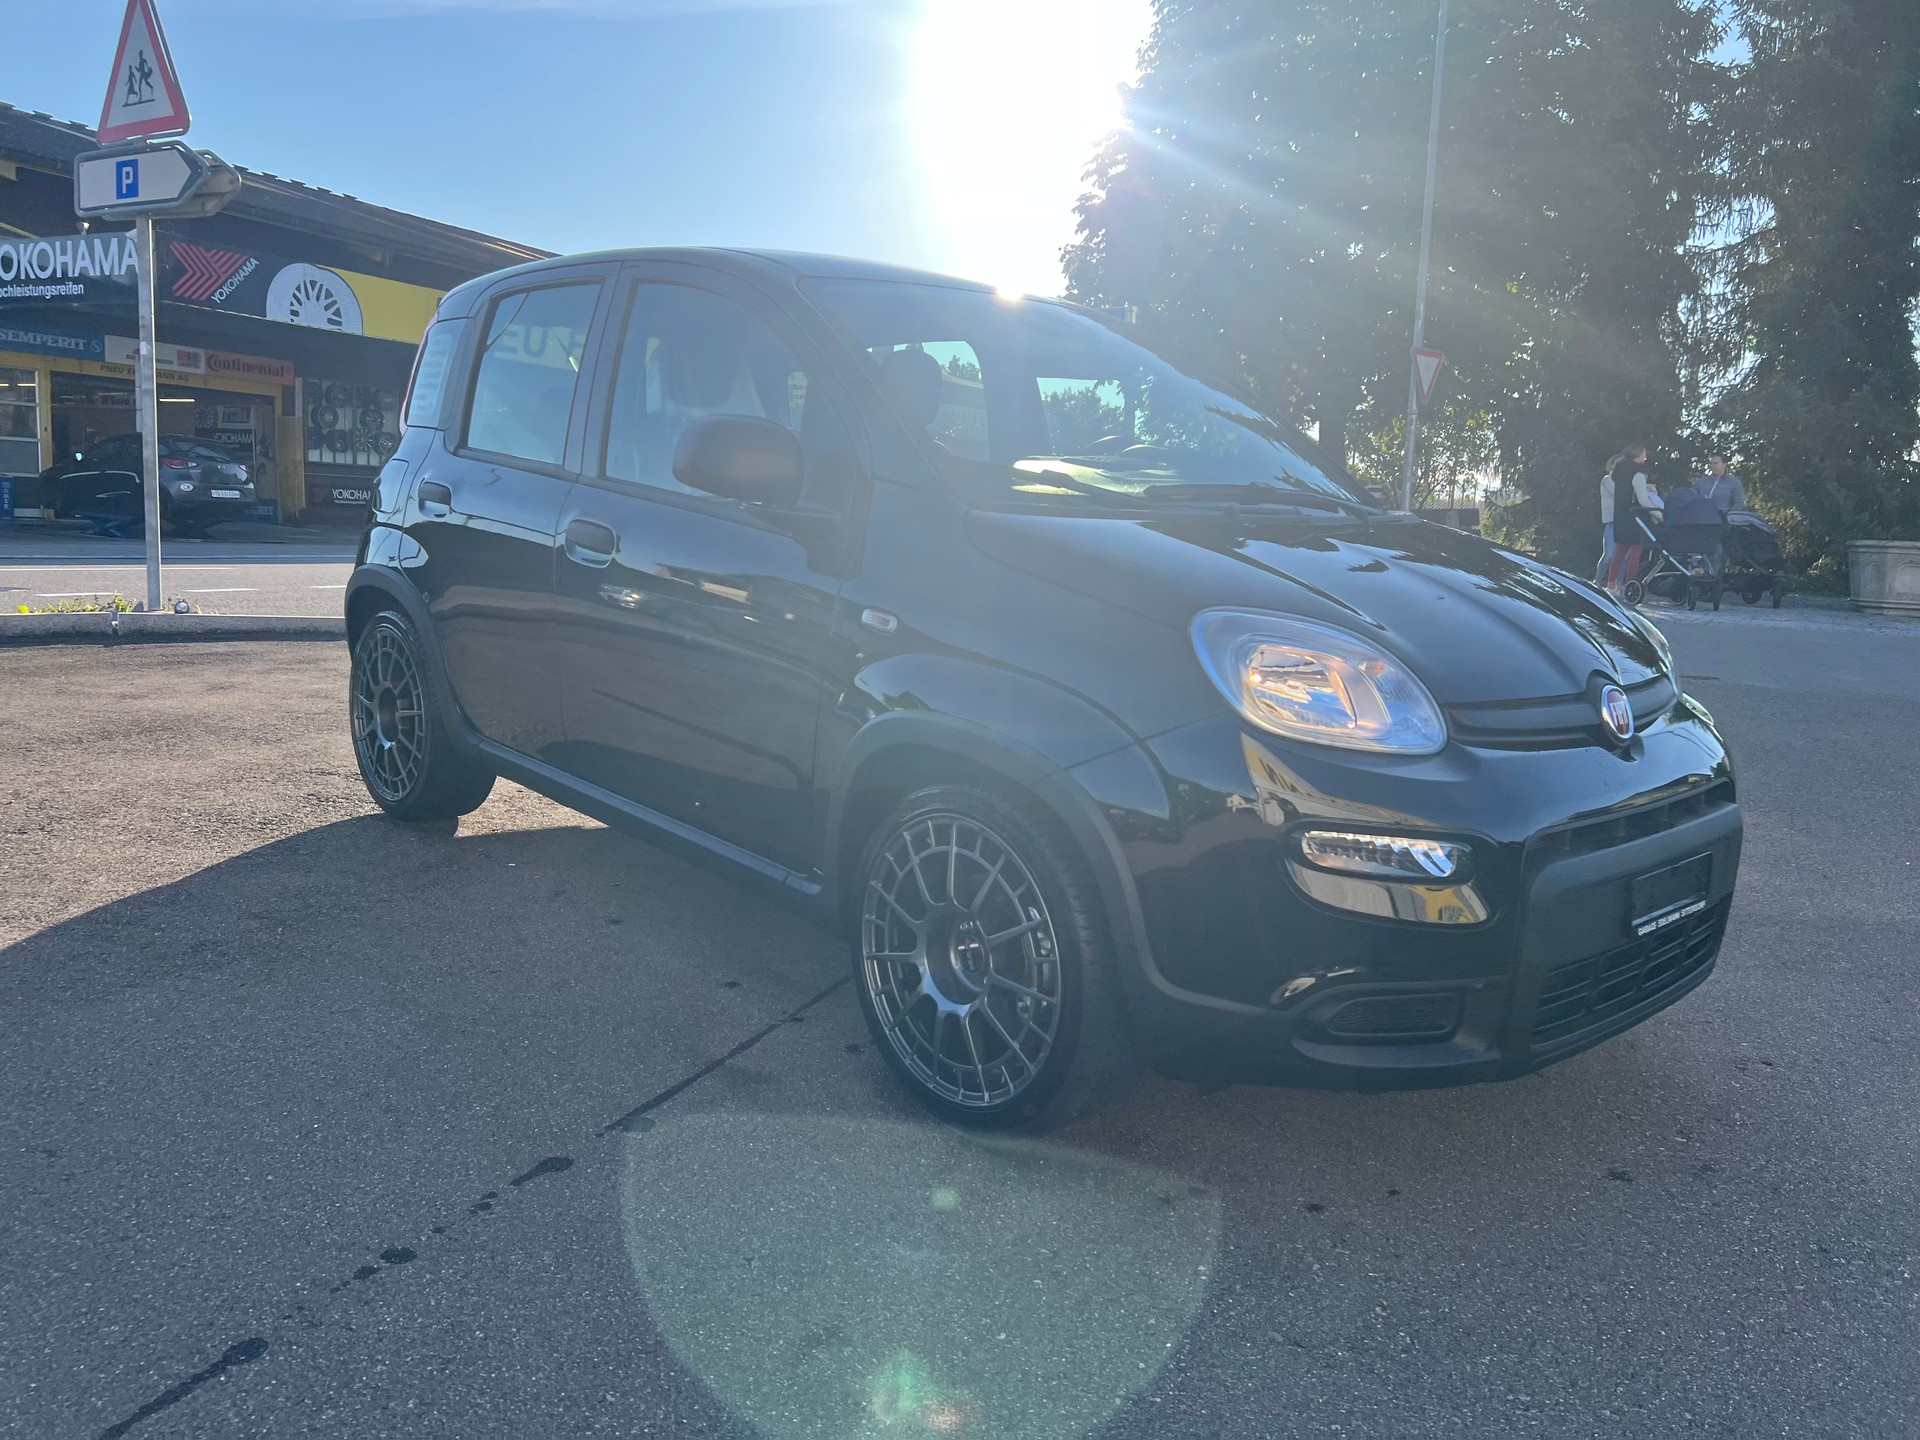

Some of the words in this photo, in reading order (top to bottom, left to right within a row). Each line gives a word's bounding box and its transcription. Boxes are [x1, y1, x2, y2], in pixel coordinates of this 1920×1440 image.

[122, 166, 134, 194] P
[211, 257, 260, 304] YOKOHAMA
[0, 329, 88, 350] SEMPERIT
[206, 354, 285, 377] Continental
[212, 432, 253, 444] YOKOHAMA
[1609, 700, 1629, 727] FIAT
